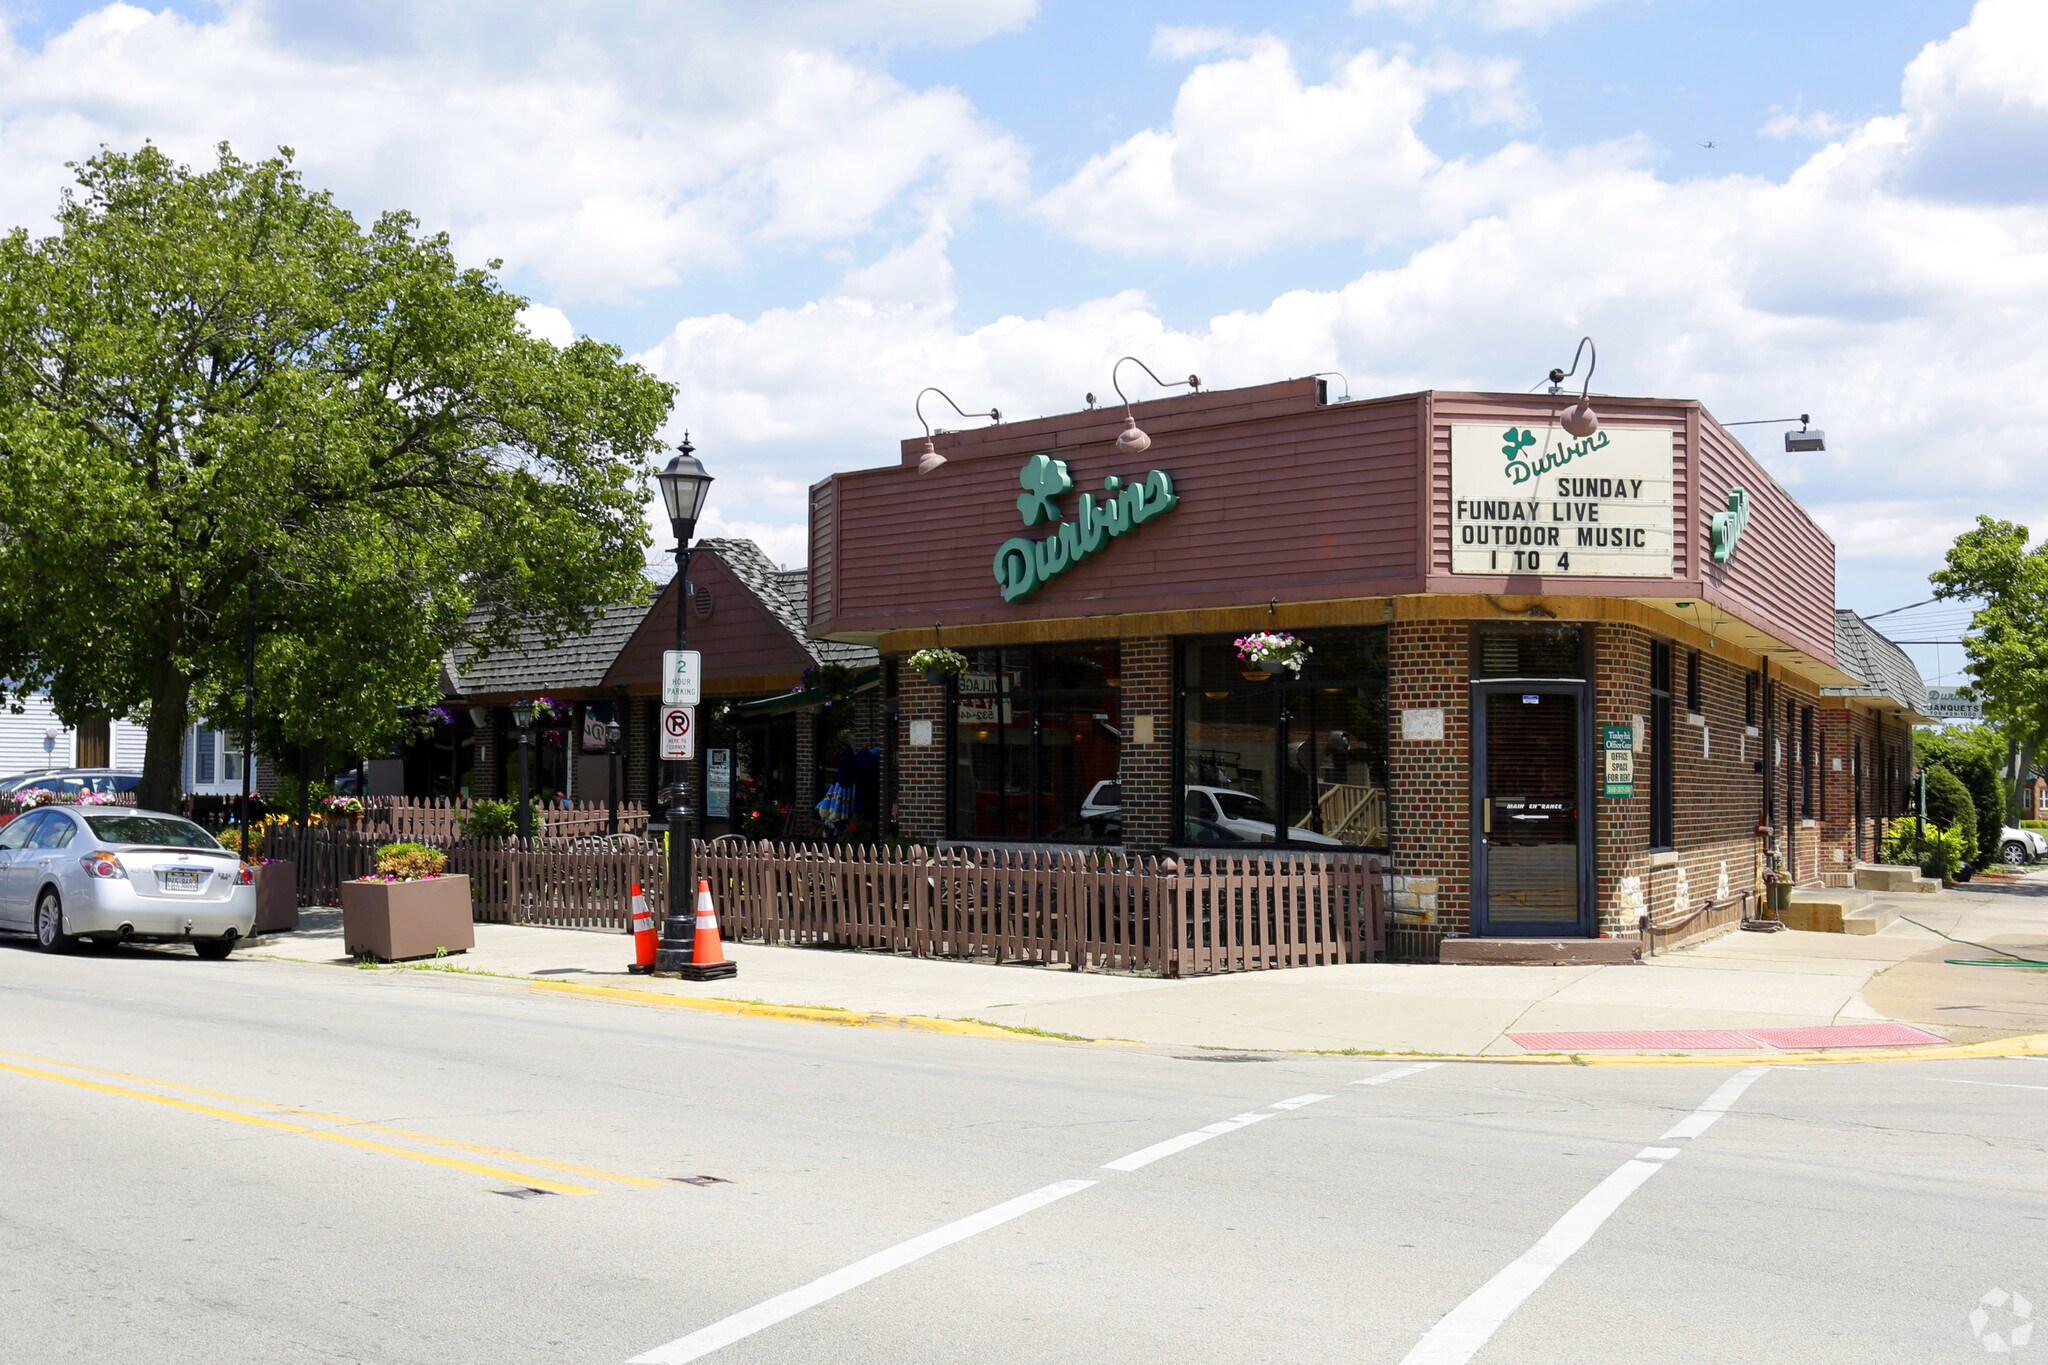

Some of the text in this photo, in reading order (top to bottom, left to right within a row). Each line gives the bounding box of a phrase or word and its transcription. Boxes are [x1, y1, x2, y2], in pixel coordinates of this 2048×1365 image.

[1505, 431, 1610, 485] Durbins
[1558, 477, 1643, 499] SUNDAY
[1457, 500, 1599, 522] FUNDAY LIVE
[993, 469, 1179, 603] Durbins
[1462, 525, 1646, 547] OUTDOOR MUSIC
[1514, 551, 1540, 570] TO
[1557, 551, 1570, 571] 4
[677, 660, 687, 673] 2
[672, 678, 691, 686] HOUR
[667, 687, 696, 695] PARKING
[1928, 690, 1977, 701] Durb
[1608, 730, 1623, 741] Tinley
[1605, 740, 1621, 749] Office
[1611, 752, 1628, 761] OFFICE
[1611, 762, 1628, 771] SPACE
[1607, 773, 1630, 782] FOR RENT
